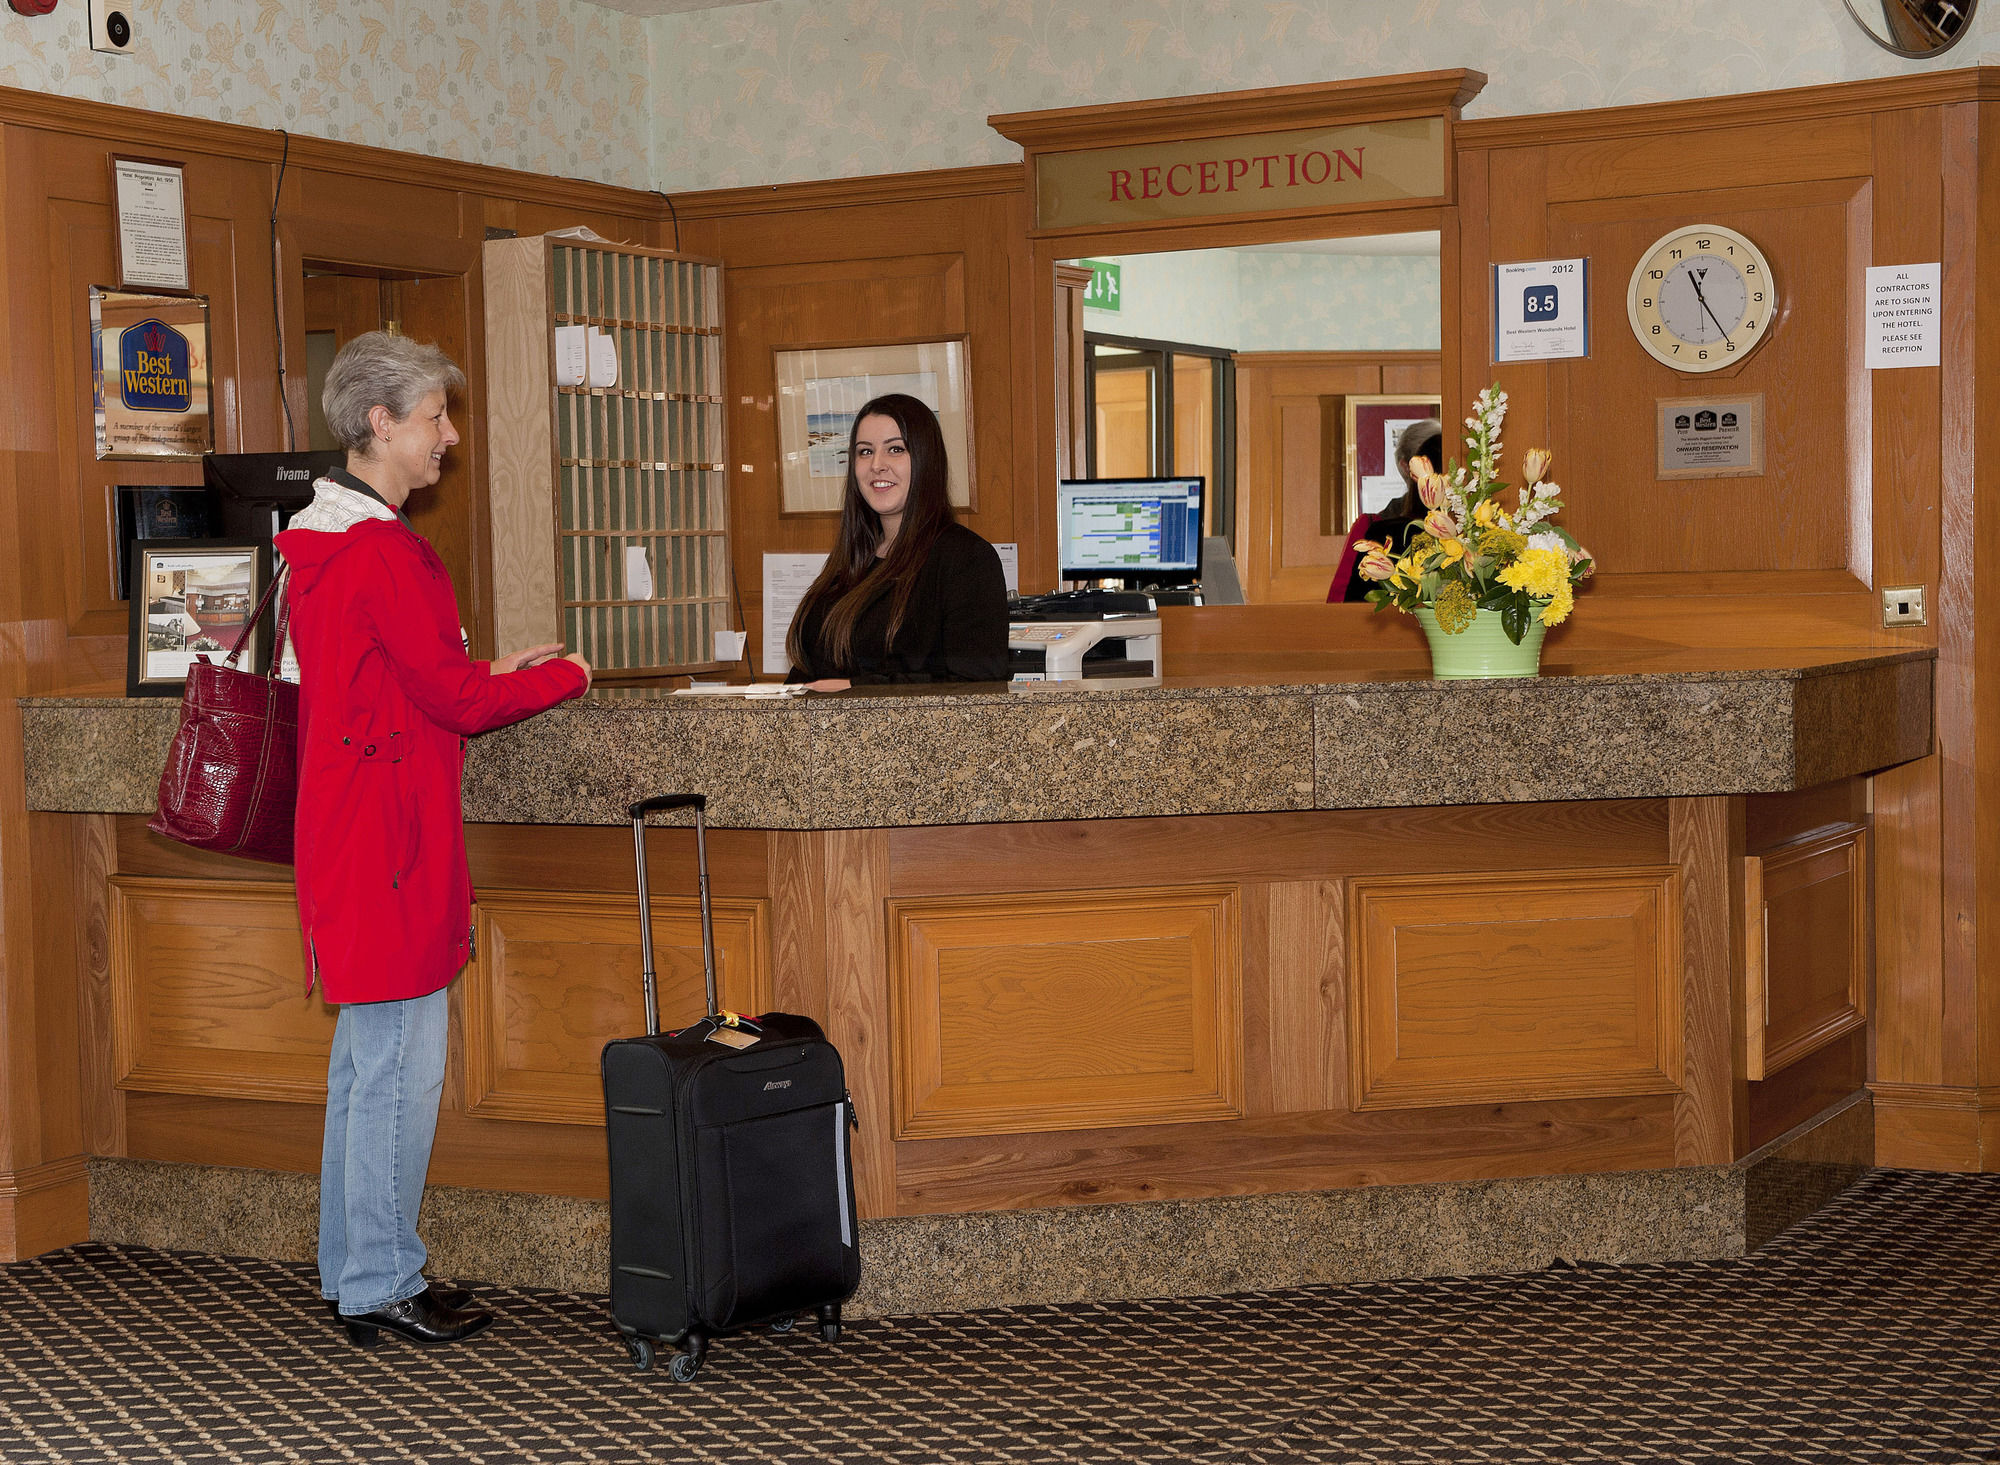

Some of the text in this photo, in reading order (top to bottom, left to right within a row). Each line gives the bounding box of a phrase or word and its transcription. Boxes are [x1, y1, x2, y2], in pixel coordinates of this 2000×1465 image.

[1108, 147, 1366, 202] RECEPTION
[1696, 240, 1711, 250] 12
[1669, 249, 1682, 259] 11
[1727, 246, 1734, 256] 1
[1552, 264, 1574, 274] 2012
[1746, 264, 1756, 274] 2
[1647, 269, 1664, 280] 10
[1875, 283, 1930, 293] CONTRACTORS
[1753, 292, 1763, 302] 3
[1902, 297, 1920, 305] SIGN
[1527, 295, 1555, 313] 8.5
[1643, 298, 1652, 308] 9
[1872, 307, 1933, 318] UPON ENTERING
[1745, 320, 1756, 330] 4
[1897, 320, 1923, 328] HOTEL.
[1651, 325, 1661, 335] 8
[1882, 333, 1922, 342] PLEASE SEE
[1671, 344, 1680, 354] 7
[1726, 342, 1735, 352] 5
[1882, 345, 1923, 354] RECEPTION
[1698, 350, 1708, 360] 6
[137, 351, 173, 375] Best
[124, 370, 188, 396] Western
[113, 422, 119, 430] A
[276, 466, 310, 481] iiyama
